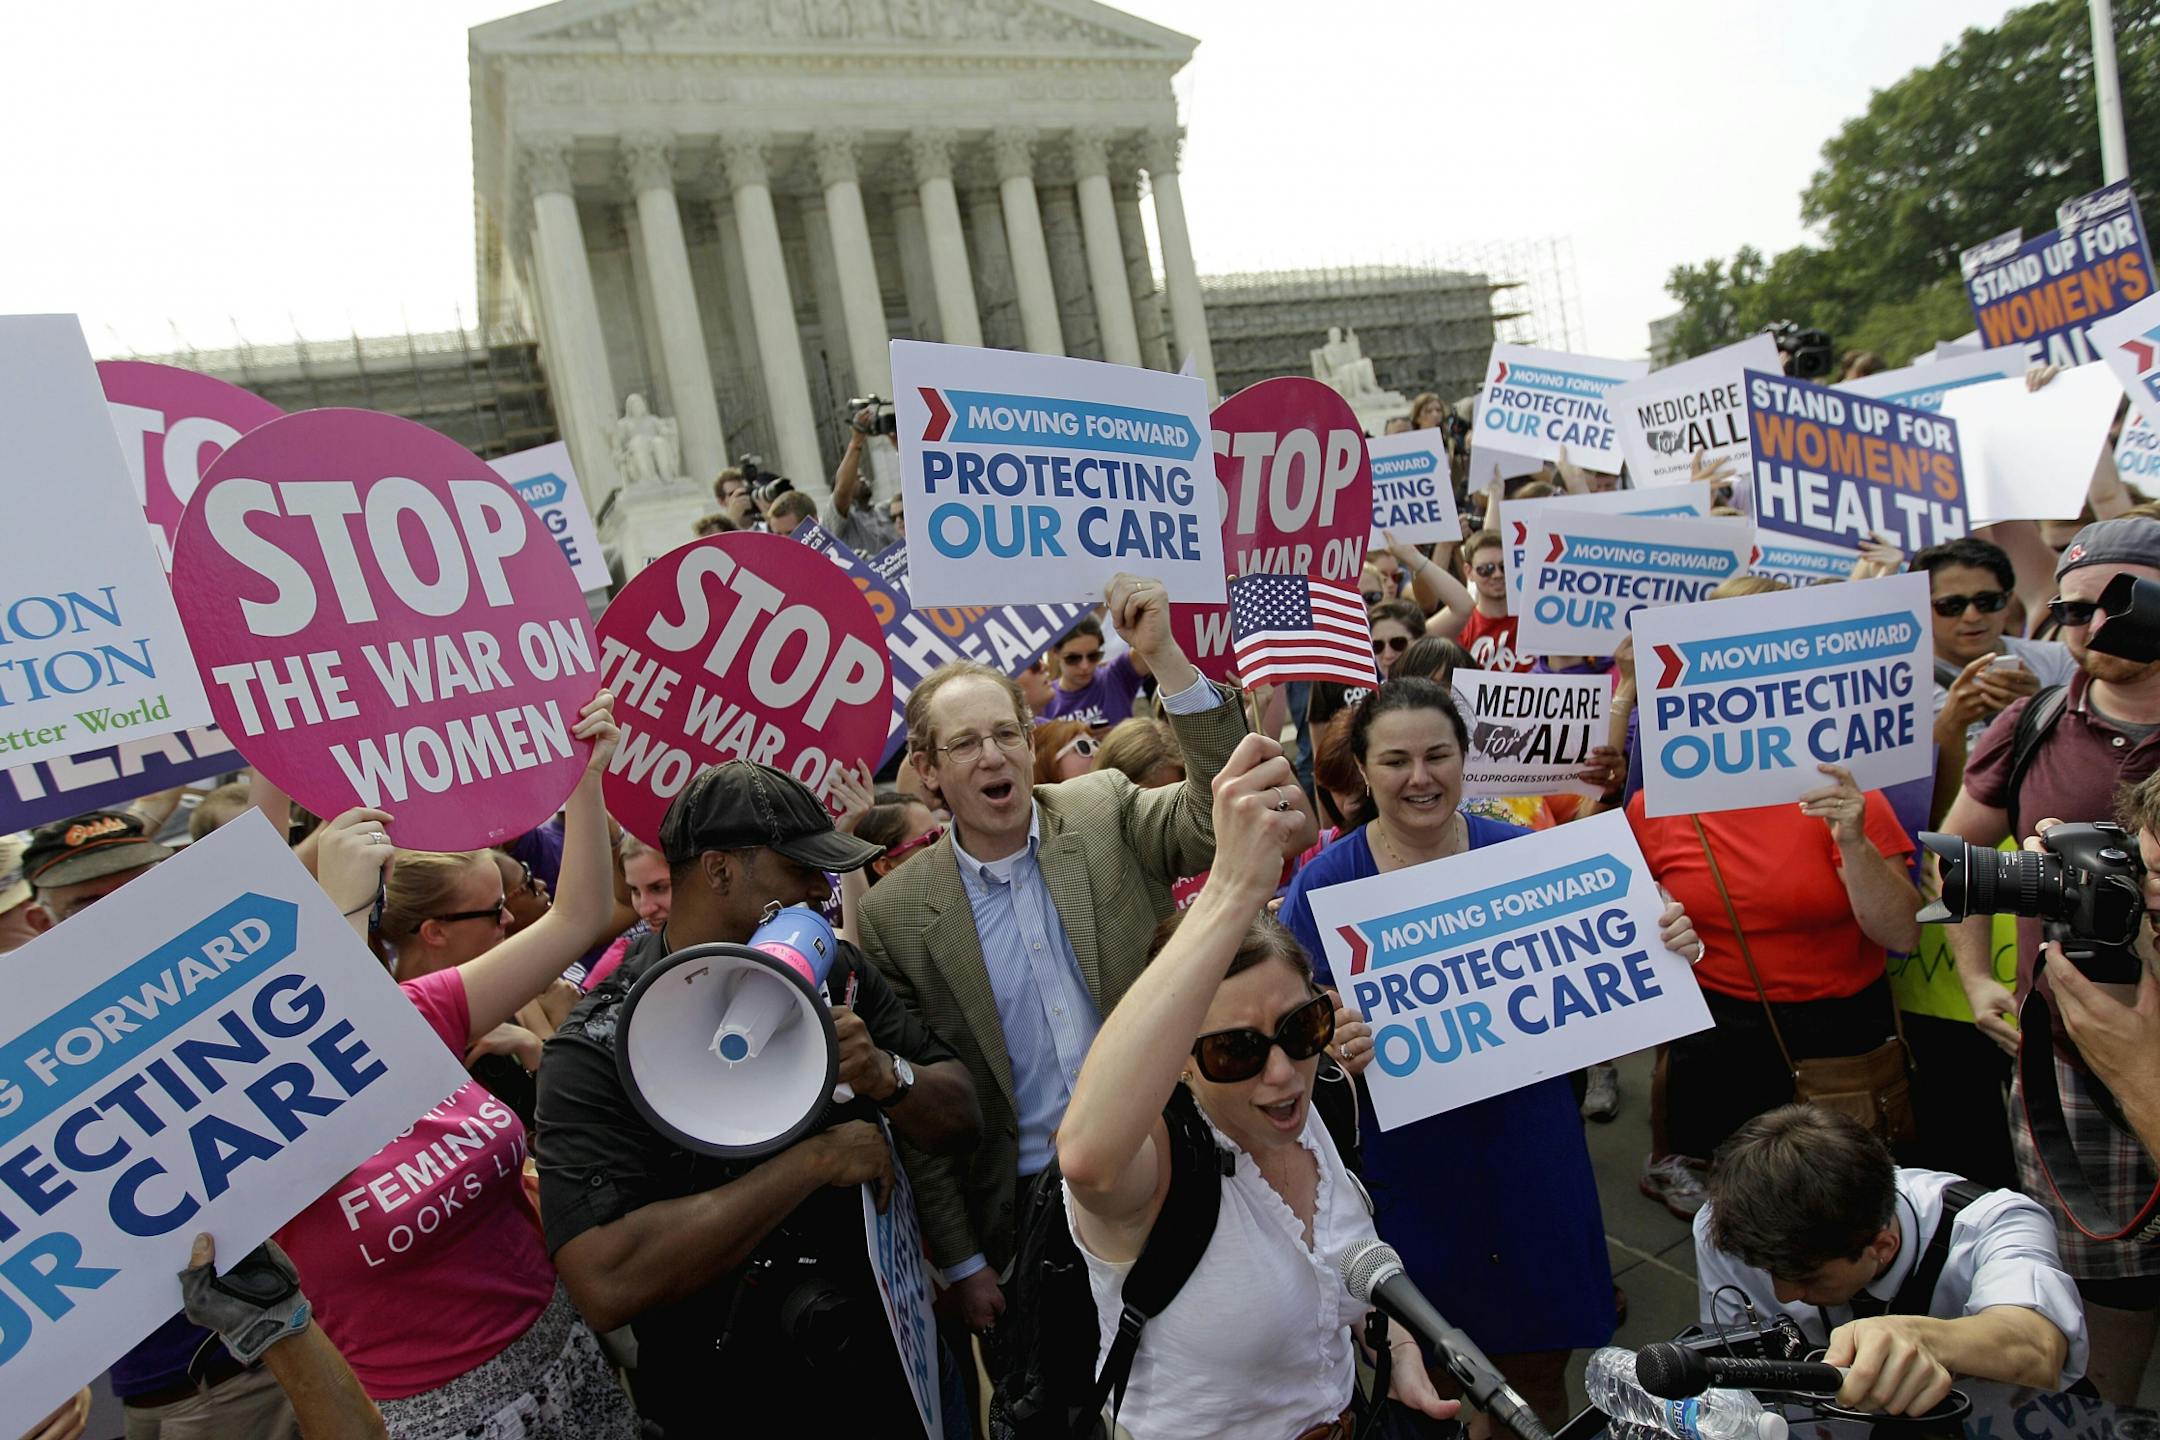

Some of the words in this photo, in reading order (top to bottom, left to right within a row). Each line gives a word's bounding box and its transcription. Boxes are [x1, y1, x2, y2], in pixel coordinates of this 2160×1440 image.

[1971, 254, 2043, 306] STAND
[2043, 238, 2077, 276] UP
[2080, 214, 2139, 262] FOR
[1980, 251, 2148, 348] WOMEN'S
[1513, 369, 1565, 387] MOVING
[1638, 383, 1742, 430] MEDICARE
[1751, 378, 1846, 427] STAND
[1852, 402, 1890, 436] UP
[1897, 412, 1954, 454] FOR
[968, 405, 1080, 437] MOVING
[1085, 414, 1190, 448] FORWARD
[1485, 407, 1542, 438] OUR
[1546, 418, 1616, 451] CARE
[1686, 413, 1749, 453] ALL
[1755, 410, 1959, 501] WOMEN'S
[922, 450, 1195, 507] PROTECTING
[1371, 500, 1442, 529] CARE
[1758, 461, 1967, 552] HEALTH
[204, 476, 527, 638] STOP
[928, 502, 1067, 559] OUR
[1077, 506, 1201, 561] CARE
[1236, 543, 1313, 576] WAR
[1321, 535, 1364, 580] ON
[1573, 543, 1646, 564] MOVING
[1649, 547, 1730, 571] FORWARD
[1767, 551, 1829, 570] MOVING
[646, 545, 886, 732] STOP
[1534, 595, 1617, 631] OUR
[1700, 640, 1810, 672] MOVING
[1815, 622, 1912, 657] FORWARD
[74, 695, 172, 735] World
[211, 650, 361, 737] THE
[362, 630, 514, 708] WAR
[517, 617, 597, 681] ON
[600, 635, 682, 720] THE
[682, 683, 786, 764] WAR
[1476, 683, 1601, 719] MEDICARE
[1656, 661, 1914, 731] PROTECTING
[329, 700, 575, 808] WOMEN
[1472, 727, 1521, 761] for
[1660, 726, 1797, 780] OUR
[1808, 702, 1914, 763] CARE
[1381, 904, 1487, 953] MOVING
[1491, 867, 1616, 921] FORWARD
[23, 917, 272, 1087] FORWARD
[1353, 908, 1637, 1024] PROTECTING
[1374, 1001, 1506, 1078] OUR
[1507, 950, 1663, 1036] CARE
[0, 974, 325, 1243] ECTING
[108, 1018, 389, 1238] CARE
[338, 1094, 513, 1231] FEMINIS
[359, 1172, 484, 1269] LOOKS
